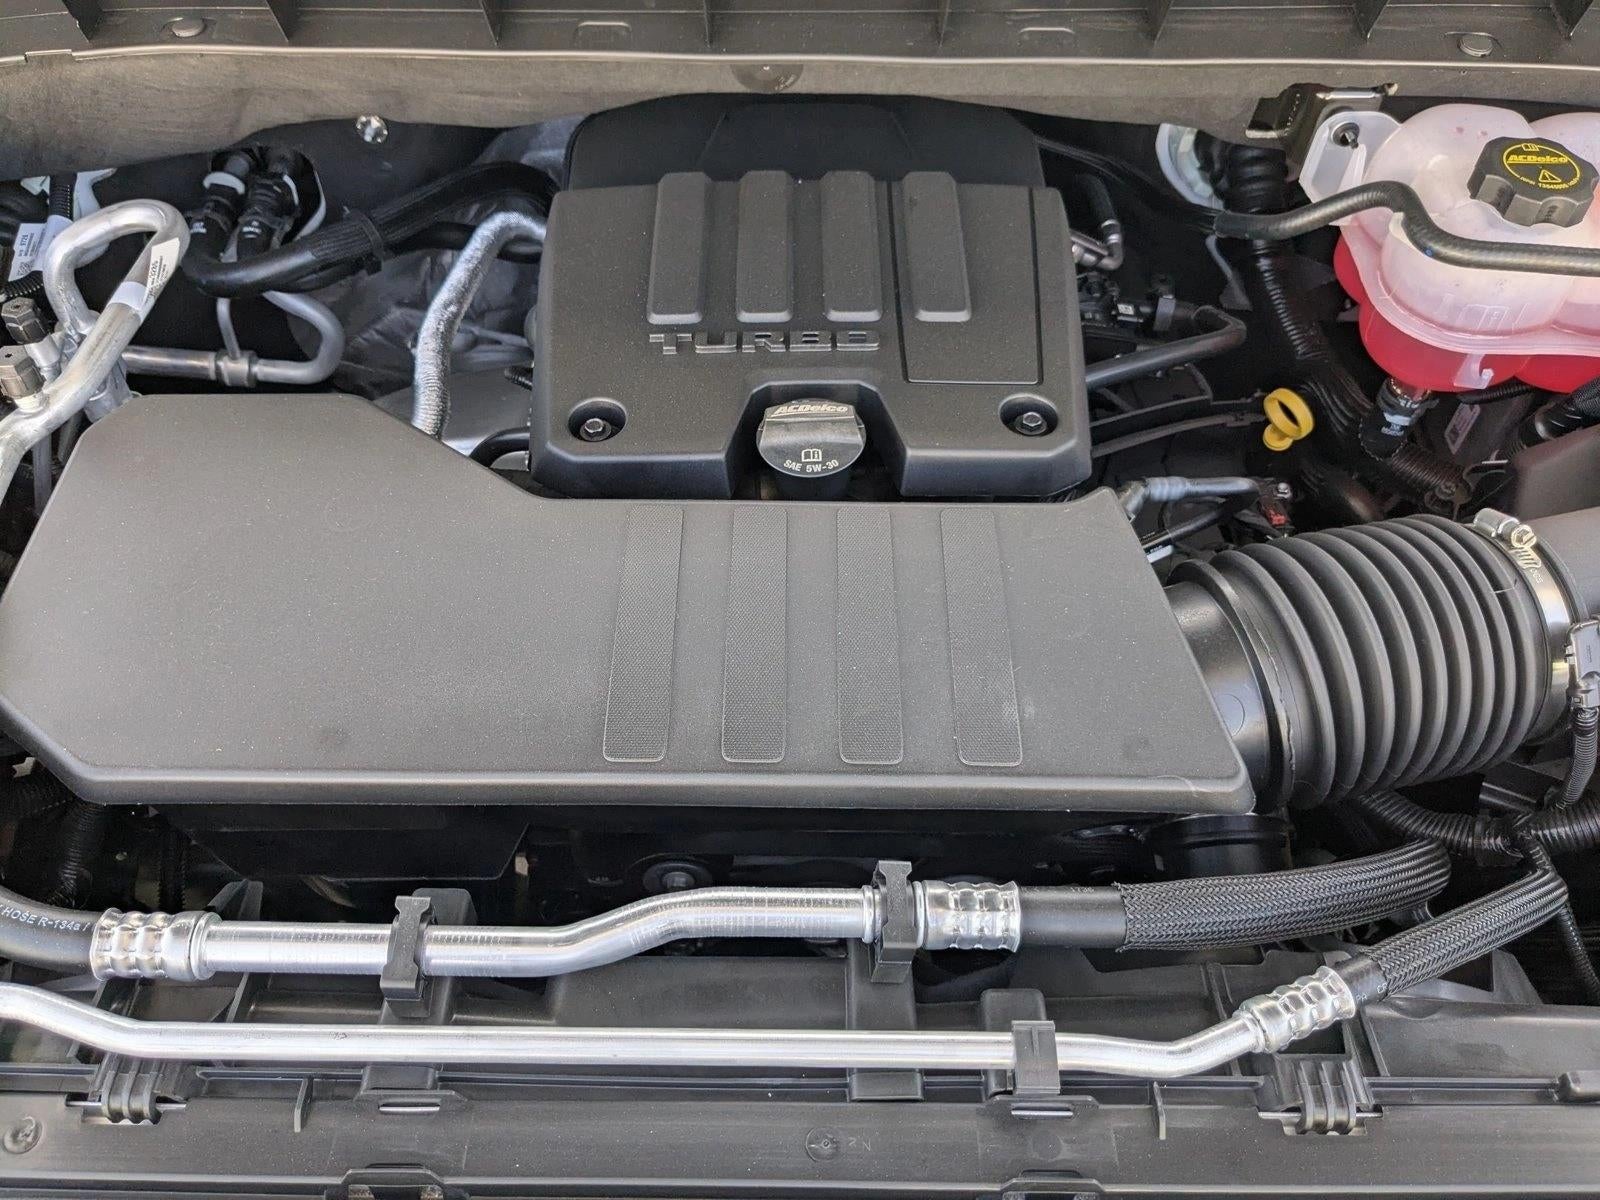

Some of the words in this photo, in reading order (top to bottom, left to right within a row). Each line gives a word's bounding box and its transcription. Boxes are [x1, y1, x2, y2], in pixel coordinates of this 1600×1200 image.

[1507, 154, 1568, 163] ACDelco
[649, 331, 881, 354] TURBO
[772, 403, 849, 417] ACDelco
[783, 459, 803, 472] SAE
[805, 459, 839, 473] 5W-30
[1, 905, 38, 924] HOSE
